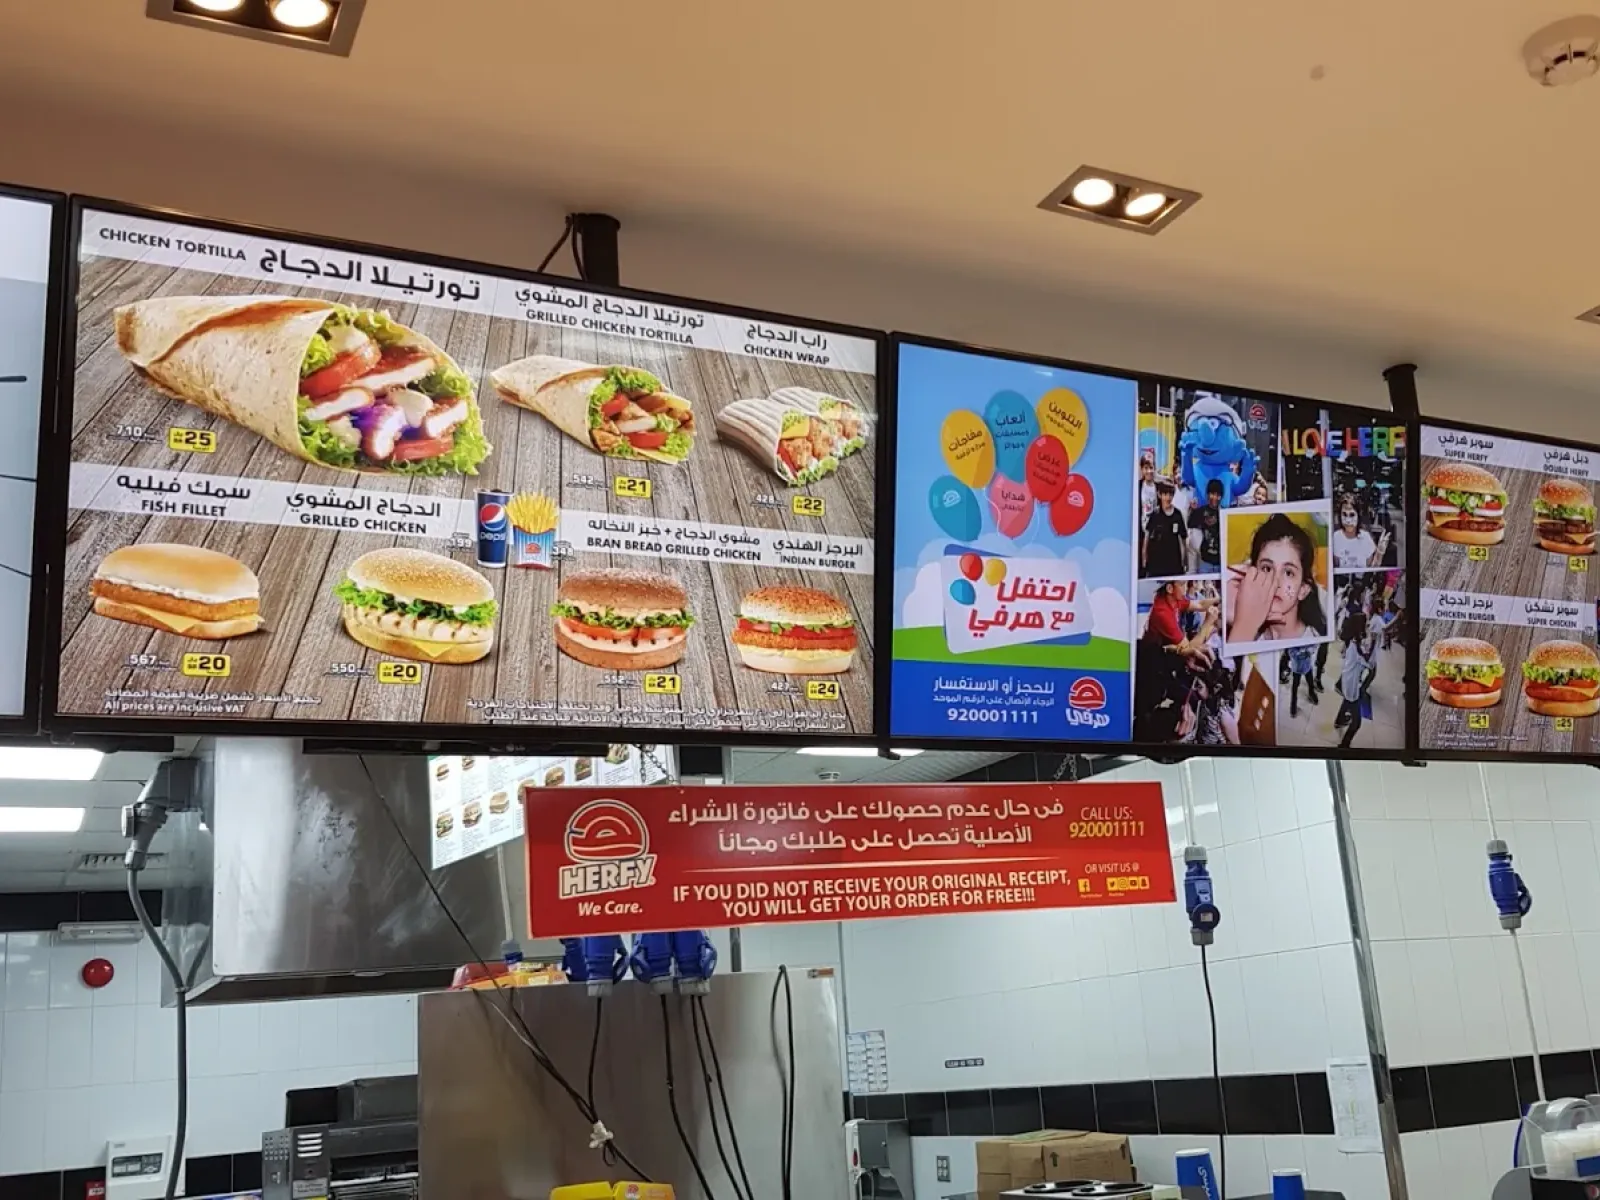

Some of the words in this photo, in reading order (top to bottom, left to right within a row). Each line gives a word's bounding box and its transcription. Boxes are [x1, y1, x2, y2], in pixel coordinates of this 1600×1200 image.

[99, 228, 170, 249] CHICKEN
[175, 239, 246, 261] TORTILLA
[260, 248, 362, 281] الدجاج
[370, 265, 481, 301] تورتيلا
[515, 286, 588, 309] المشوي
[592, 298, 648, 319] الدجاج
[525, 308, 578, 326] GRILLED
[581, 318, 636, 336] CHICKEN
[640, 327, 694, 345] TORTILLA
[653, 308, 705, 329] تورتيلا
[747, 324, 797, 344] الدجاج
[801, 334, 827, 350] راب
[744, 343, 793, 360] CHICKEN
[796, 351, 830, 365] WRAP
[116, 425, 142, 437] 710
[185, 431, 211, 446] 25
[1444, 449, 1465, 459] SUPER
[1467, 452, 1488, 462] HERFY
[1543, 464, 1568, 474] DOUBLE
[1570, 467, 1589, 477] HERFY
[117, 474, 181, 496] فيليه
[188, 480, 250, 500] سمك
[627, 479, 646, 492] 21
[141, 499, 176, 513] FISH
[182, 503, 226, 517] FILLET
[286, 488, 371, 513] المشوي
[376, 498, 441, 517] الدجاج
[804, 498, 822, 511] 22
[300, 513, 359, 528] GRILLED
[364, 519, 427, 534] CHICKEN
[638, 523, 661, 538] خبز
[674, 527, 716, 541] الدجاج
[587, 537, 622, 549] BRAN
[624, 539, 662, 553] BREAD
[665, 543, 710, 557] GRILLED
[713, 547, 761, 561] CHICKEN
[780, 555, 815, 566] INDIAN
[819, 558, 855, 569] BURGER
[997, 576, 1077, 602] احتفل
[1439, 593, 1470, 607] الدجاج
[968, 604, 1045, 638] هرفي
[1051, 610, 1075, 631] مع
[1436, 610, 1466, 620] CHICKEN
[1468, 612, 1495, 621] BURGER
[1527, 617, 1547, 625] SUPER
[1549, 620, 1577, 628] CHICKEN
[129, 654, 157, 665] 567
[199, 656, 226, 670] 20
[332, 663, 355, 672] 550
[393, 664, 417, 678] 20
[657, 676, 676, 688] 21
[817, 683, 836, 695] 24
[933, 676, 998, 692] الاستفسار
[1017, 681, 1055, 696] للحجز
[105, 700, 120, 710] All
[122, 702, 154, 712] prices
[157, 704, 173, 712] are
[177, 703, 223, 713] inclusive
[225, 704, 246, 713] VAT
[947, 708, 1038, 724] 920001111
[668, 799, 738, 826] الشراء
[743, 801, 810, 825] فاتورة
[814, 801, 858, 823] على
[863, 800, 942, 822] حصولك
[947, 802, 990, 820] عدم
[994, 799, 1030, 820] حال
[1081, 807, 1111, 820] CALL
[1114, 806, 1133, 820] US:
[898, 827, 960, 850] تحصل
[964, 822, 1032, 848] الأصلية
[1069, 821, 1144, 838] 920001111
[782, 830, 847, 853] طلبك
[851, 829, 893, 851] على
[560, 855, 656, 898] HERFY
[1085, 864, 1097, 874] OR
[1098, 863, 1118, 873] VISIT
[1120, 862, 1130, 872] US
[673, 886, 690, 902] IF
[693, 884, 731, 901] YOU
[737, 882, 769, 899] DID
[773, 880, 809, 897] NOT
[813, 877, 880, 896] RECEIVE
[884, 875, 928, 892] YOUR
[931, 873, 1006, 890] ORIGINAL
[1009, 870, 1071, 887] RECEIPT,
[578, 901, 601, 916] We
[604, 900, 643, 914] Care.
[722, 902, 760, 918] YOU
[764, 899, 806, 916] WILL
[810, 897, 842, 913] GET
[846, 894, 891, 912] YOUR
[895, 892, 949, 909] ORDER
[952, 890, 983, 906] FOR
[986, 888, 1035, 904] FREE!!!
